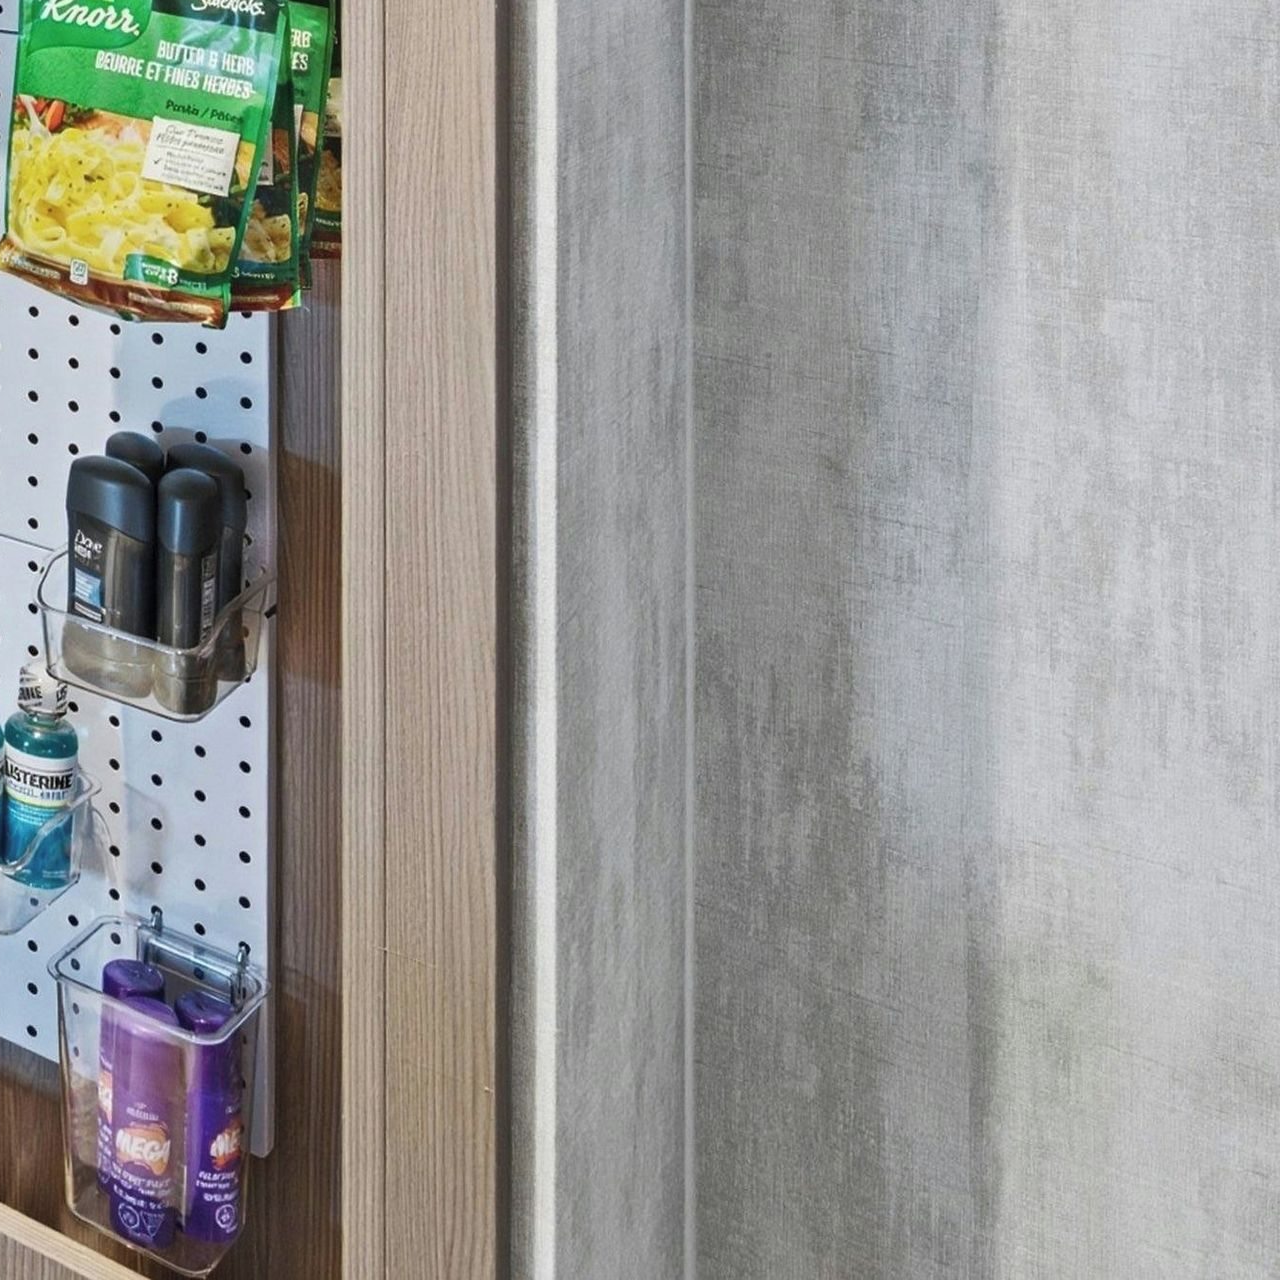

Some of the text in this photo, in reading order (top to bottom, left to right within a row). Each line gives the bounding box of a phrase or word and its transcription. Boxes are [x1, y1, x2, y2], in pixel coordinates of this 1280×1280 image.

[95, 50, 253, 100] BEURRE ET FINES HERBES
[157, 40, 205, 66] BUTTER
[221, 52, 255, 77] HERB
[5, 759, 74, 790] LISTERINE
[115, 1128, 172, 1164] MEGA
